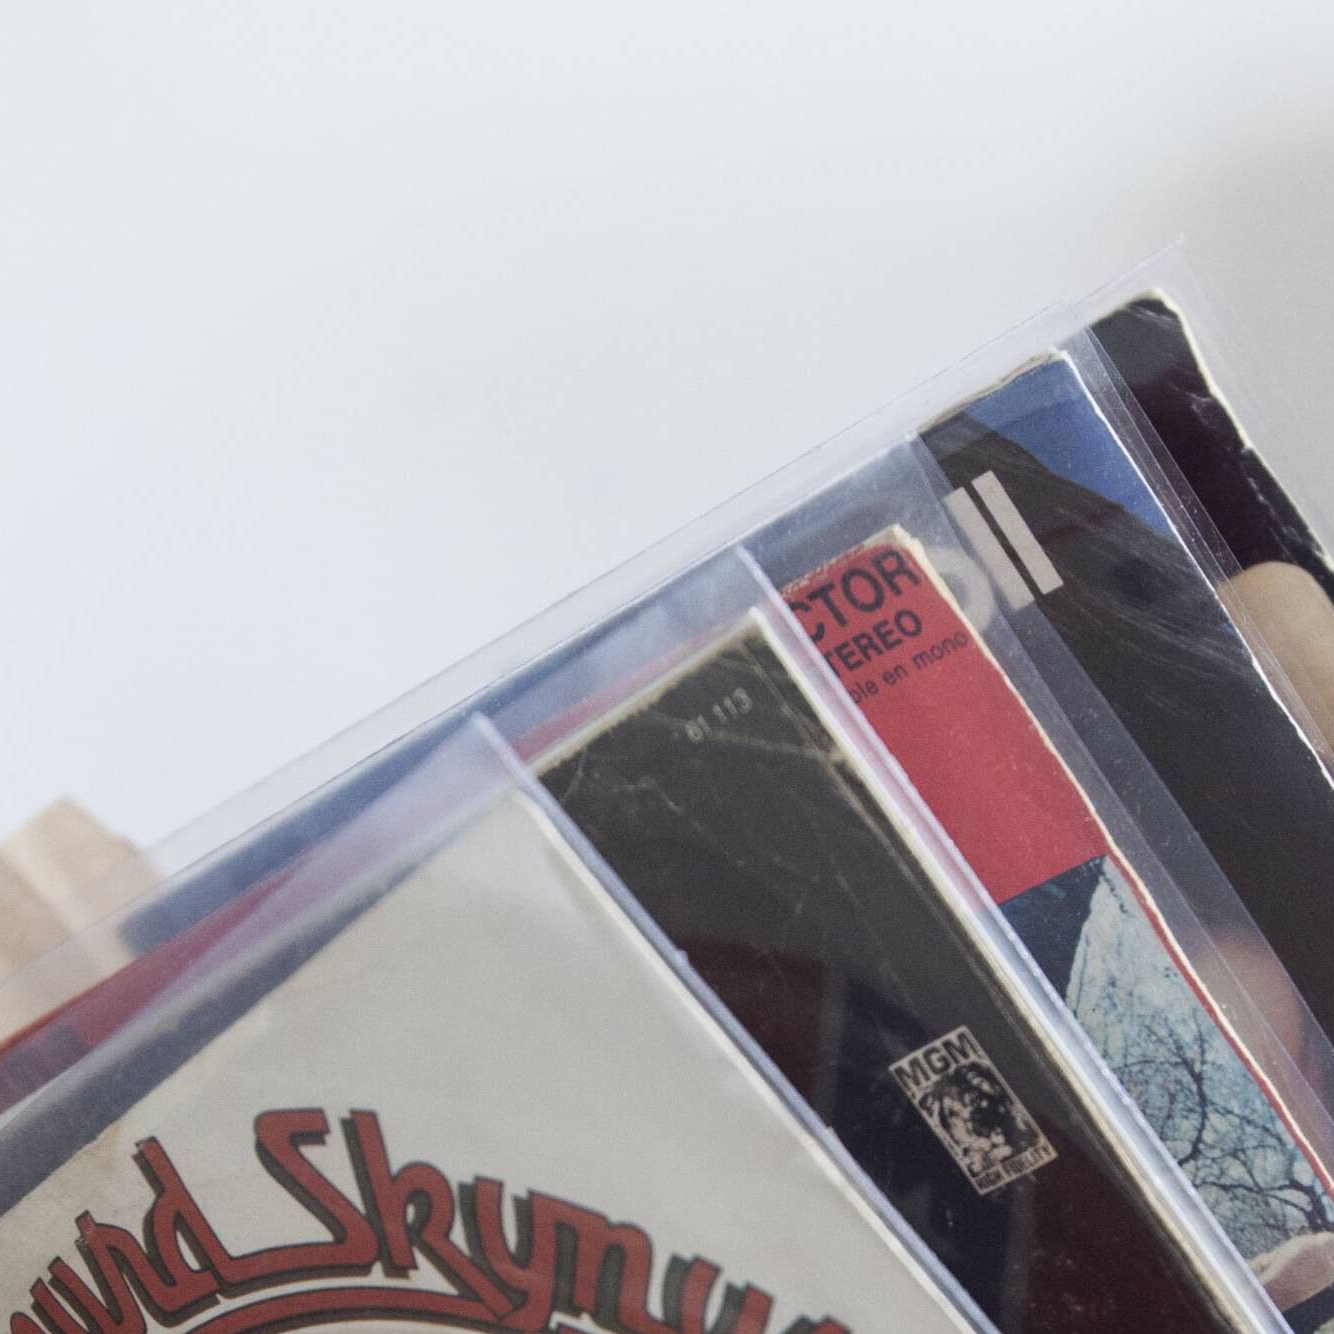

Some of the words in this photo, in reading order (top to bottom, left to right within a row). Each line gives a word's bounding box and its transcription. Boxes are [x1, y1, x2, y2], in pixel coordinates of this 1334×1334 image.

[882, 663, 908, 685] en
[912, 631, 967, 669] mono
[894, 1031, 980, 1090] MGM
